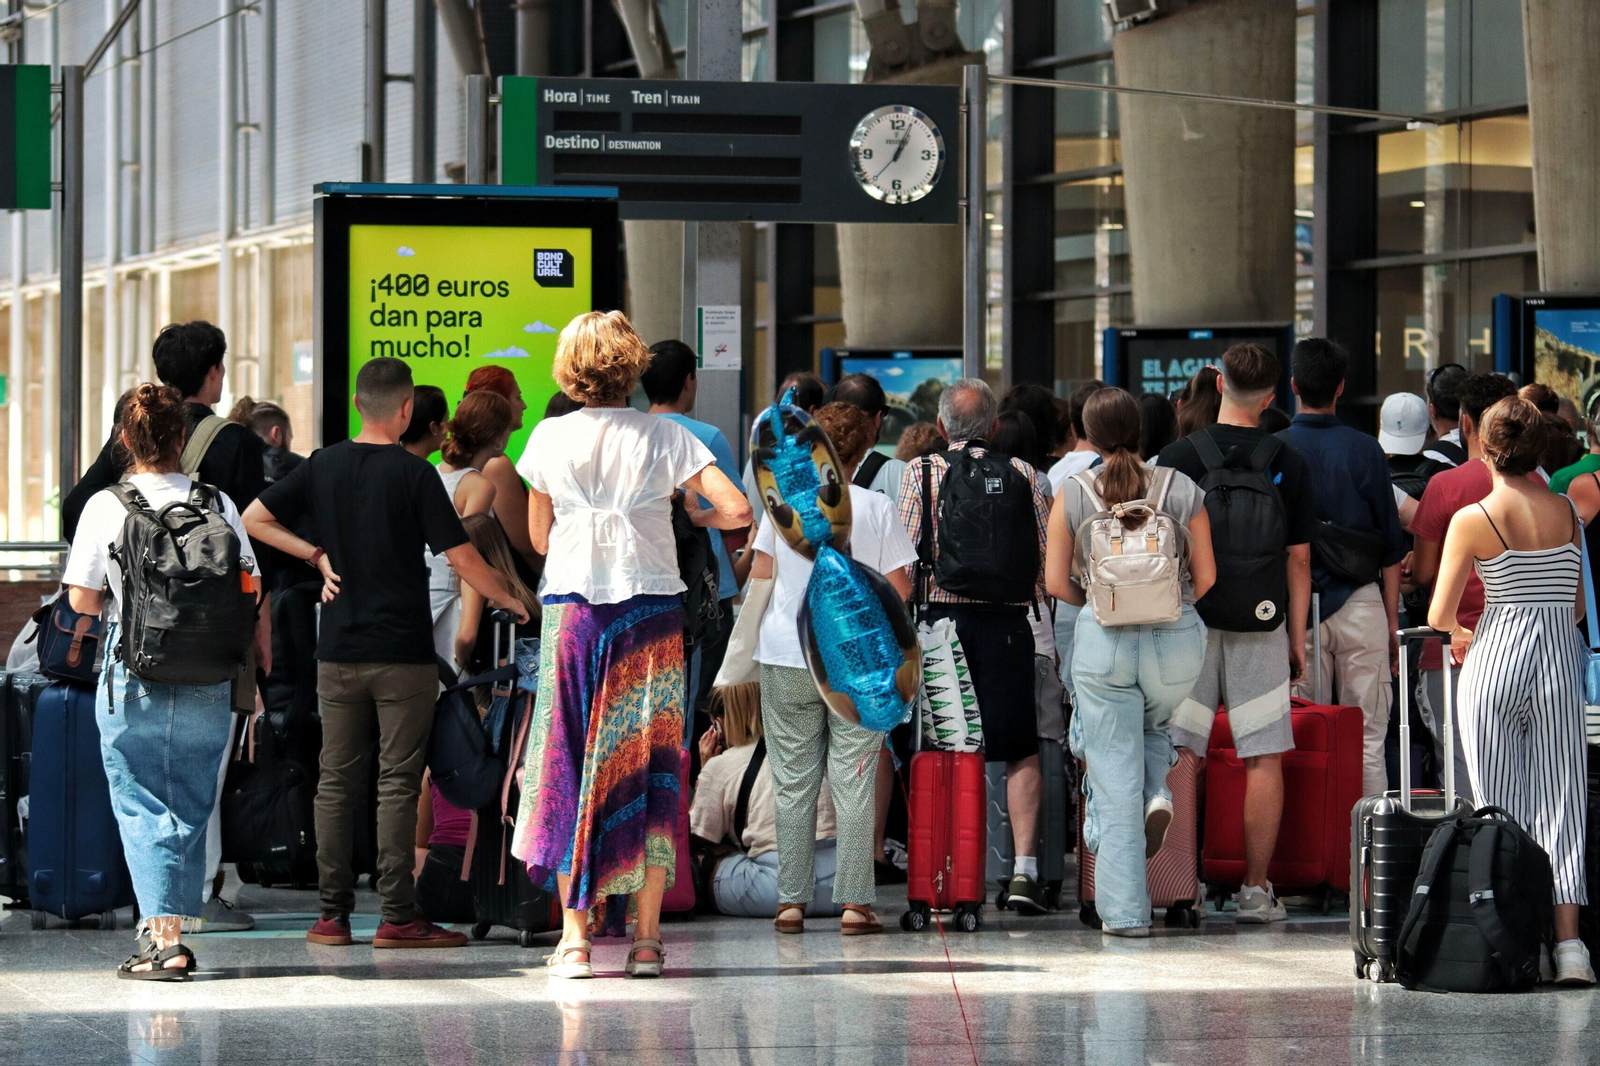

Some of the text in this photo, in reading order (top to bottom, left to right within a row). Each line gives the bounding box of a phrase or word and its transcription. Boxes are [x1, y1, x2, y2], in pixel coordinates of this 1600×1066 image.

[544, 88, 701, 105] Hora TIME Tren TRAIN
[890, 120, 906, 130] 12
[545, 135, 662, 150] Destino DESTINATION
[863, 148, 873, 160] 9
[921, 150, 931, 161] 3
[330, 183, 351, 192] global
[892, 180, 902, 190] 6
[537, 252, 564, 261] BONO
[537, 260, 563, 269] CULT
[537, 268, 564, 277] URAL
[370, 273, 510, 303] ¡400 euros
[370, 303, 483, 332] dan para
[371, 334, 471, 359] mucho!
[1143, 359, 1165, 378] EL
